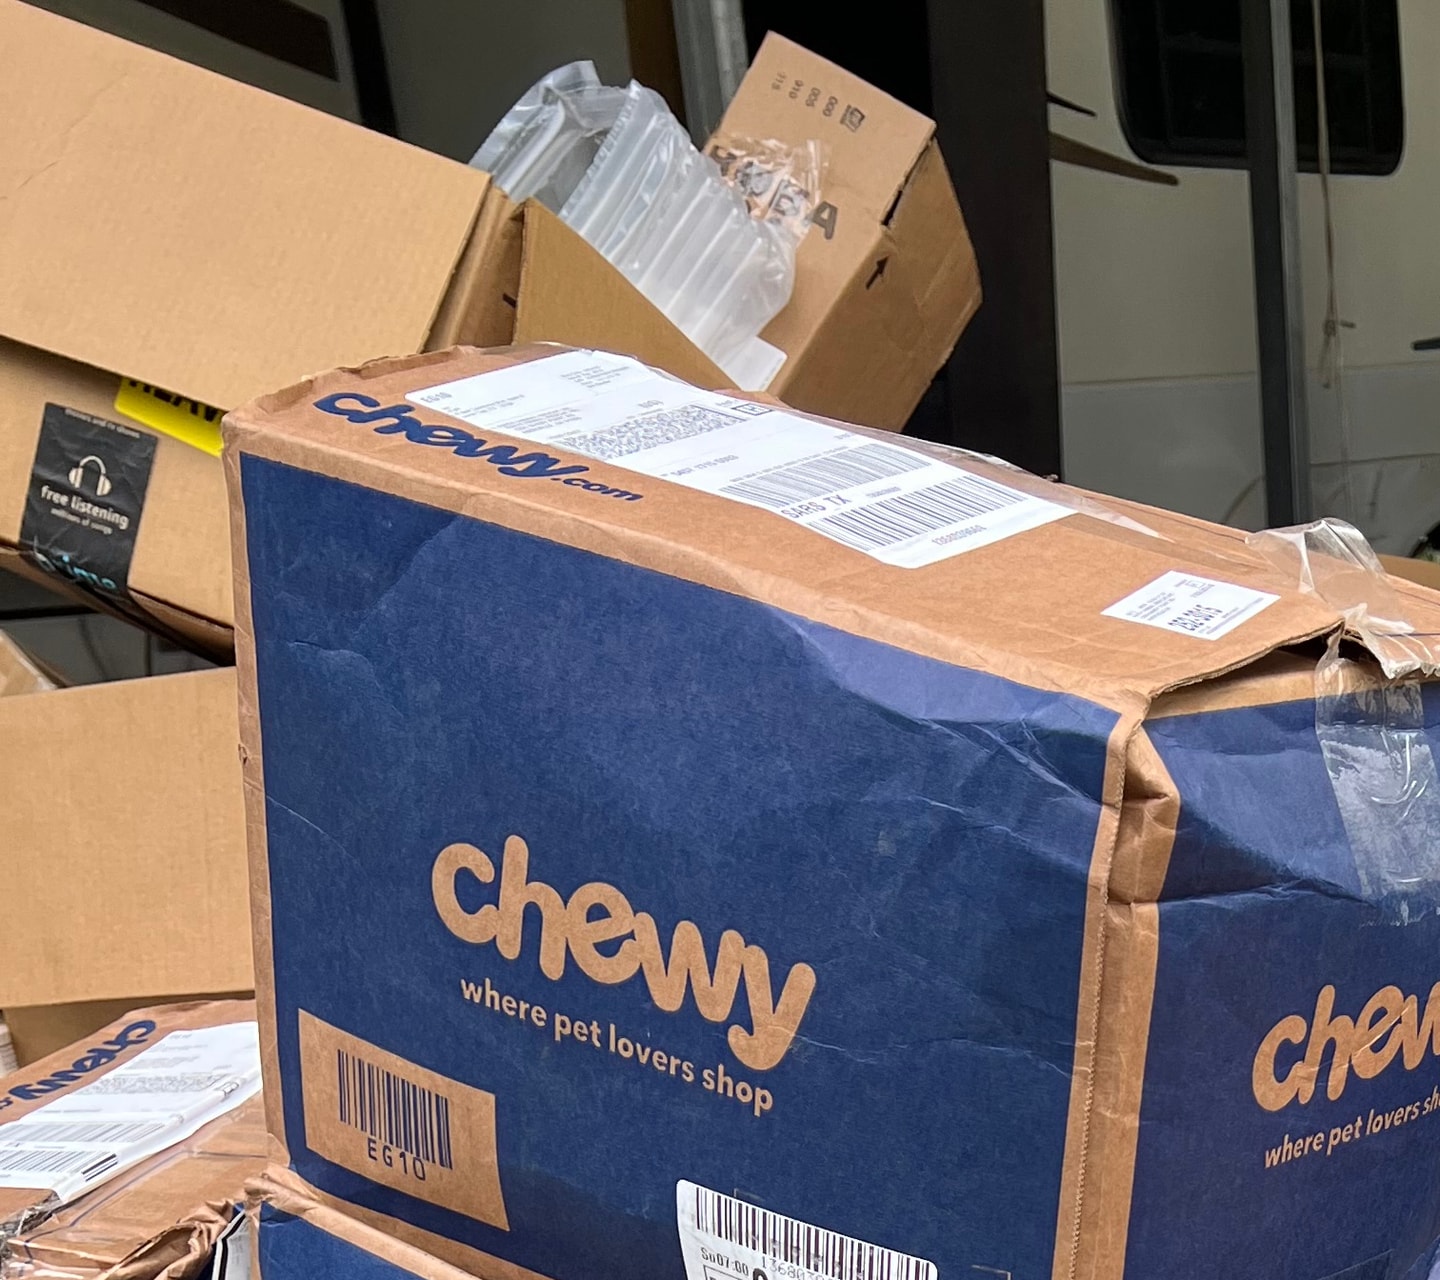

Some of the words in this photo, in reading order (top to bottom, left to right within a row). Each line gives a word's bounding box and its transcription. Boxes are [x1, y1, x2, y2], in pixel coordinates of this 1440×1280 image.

[40, 485, 69, 506] free
[71, 495, 130, 530] listening
[431, 835, 816, 1070] chewy
[461, 978, 547, 1027] where
[554, 1010, 601, 1048] pet
[609, 1024, 694, 1082] lovers
[702, 1064, 774, 1116] shop
[368, 1136, 426, 1182] EG10
[1264, 1134, 1324, 1169] where
[1327, 1117, 1362, 1156] pet
[1365, 1099, 1420, 1136] lovers
